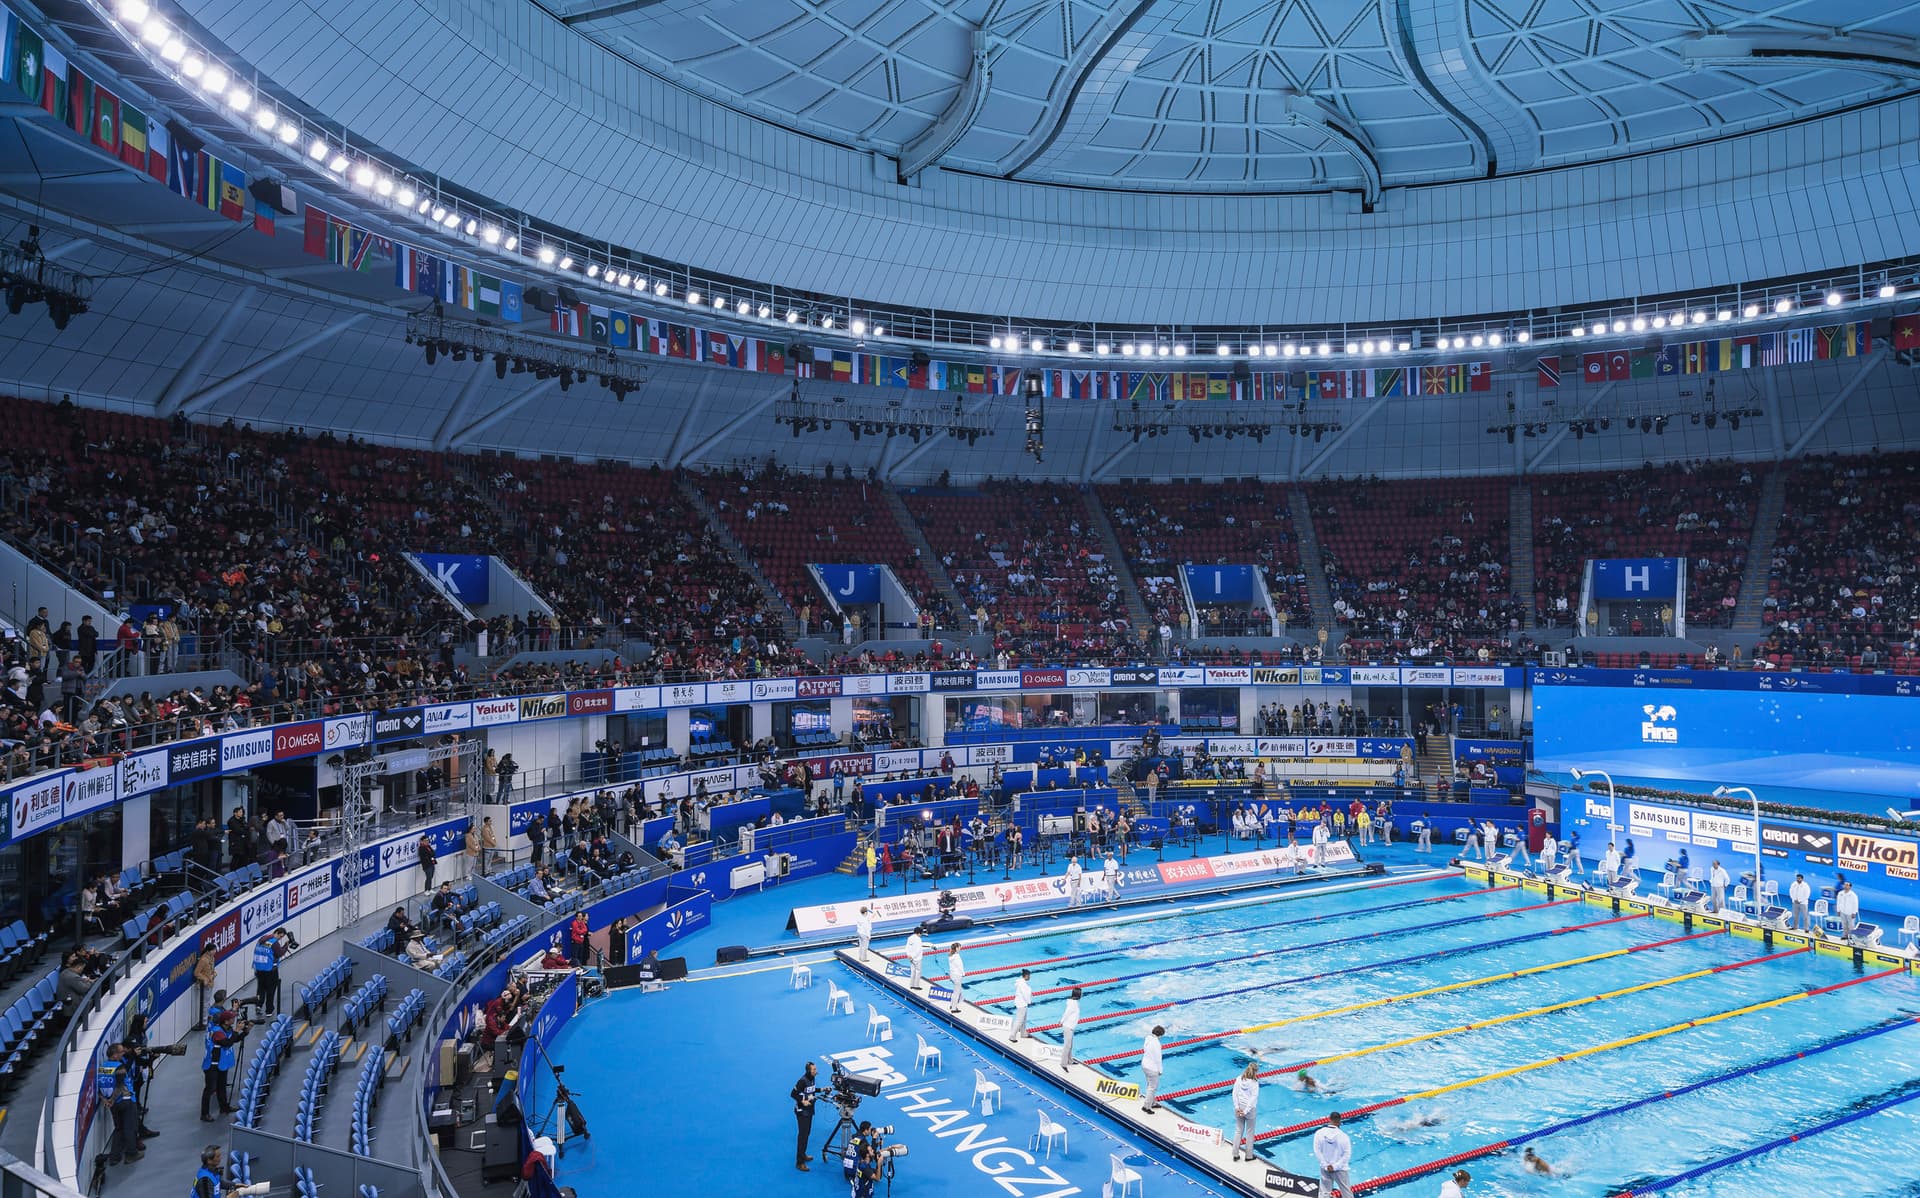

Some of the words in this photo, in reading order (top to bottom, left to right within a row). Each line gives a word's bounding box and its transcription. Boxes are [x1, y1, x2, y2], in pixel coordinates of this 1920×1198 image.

[437, 563, 460, 593] K
[840, 571, 855, 595] J
[1215, 571, 1221, 594] I
[1625, 566, 1650, 592] H
[978, 676, 1019, 684] SAMSUNG
[1114, 673, 1136, 681] arena
[1208, 670, 1248, 678] Yakult
[1254, 670, 1298, 682] Nikon
[811, 681, 841, 689] TOMIC
[426, 709, 443, 723] ANA
[476, 702, 516, 715] Yakult
[522, 699, 565, 718] Nikon
[376, 718, 400, 733] arena
[1642, 722, 1677, 740] Fina
[288, 733, 320, 749] OMEGA
[223, 738, 271, 761] SAMSUNG
[172, 747, 217, 772] 浦发信用卡
[843, 757, 873, 767] TOMIC
[77, 773, 113, 801] 杭州解百
[31, 785, 60, 811] 利亚德
[1633, 810, 1686, 826] SAMSUNG
[1696, 818, 1753, 837] 浦发信用卡
[1762, 828, 1799, 845] arena
[1840, 837, 1915, 865] Nikon
[1165, 863, 1207, 879] 农夫山泉
[1839, 860, 1867, 871] Nikon
[1887, 867, 1917, 880] Nikon
[1014, 882, 1049, 893] 利亚德
[883, 899, 930, 911] 中国体育彩票
[1096, 1080, 1138, 1098] Nikon
[1176, 1123, 1211, 1138] Yakult
[1266, 1172, 1294, 1189] arena
